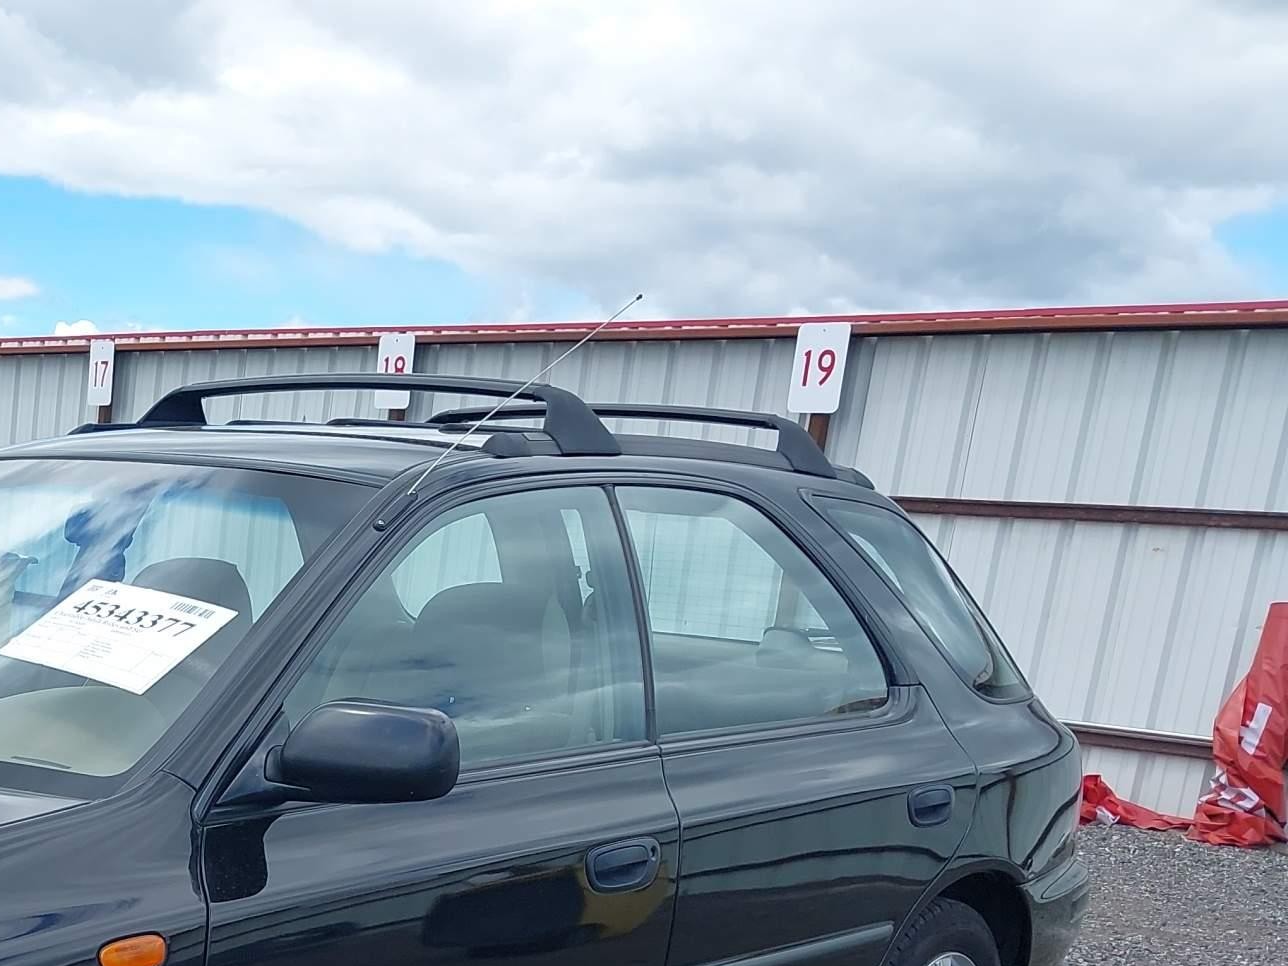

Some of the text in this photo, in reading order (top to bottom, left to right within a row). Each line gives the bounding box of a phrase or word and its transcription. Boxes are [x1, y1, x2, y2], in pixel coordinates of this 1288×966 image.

[93, 360, 109, 388] 17
[801, 349, 836, 387] 19
[72, 599, 197, 637] 45343377
